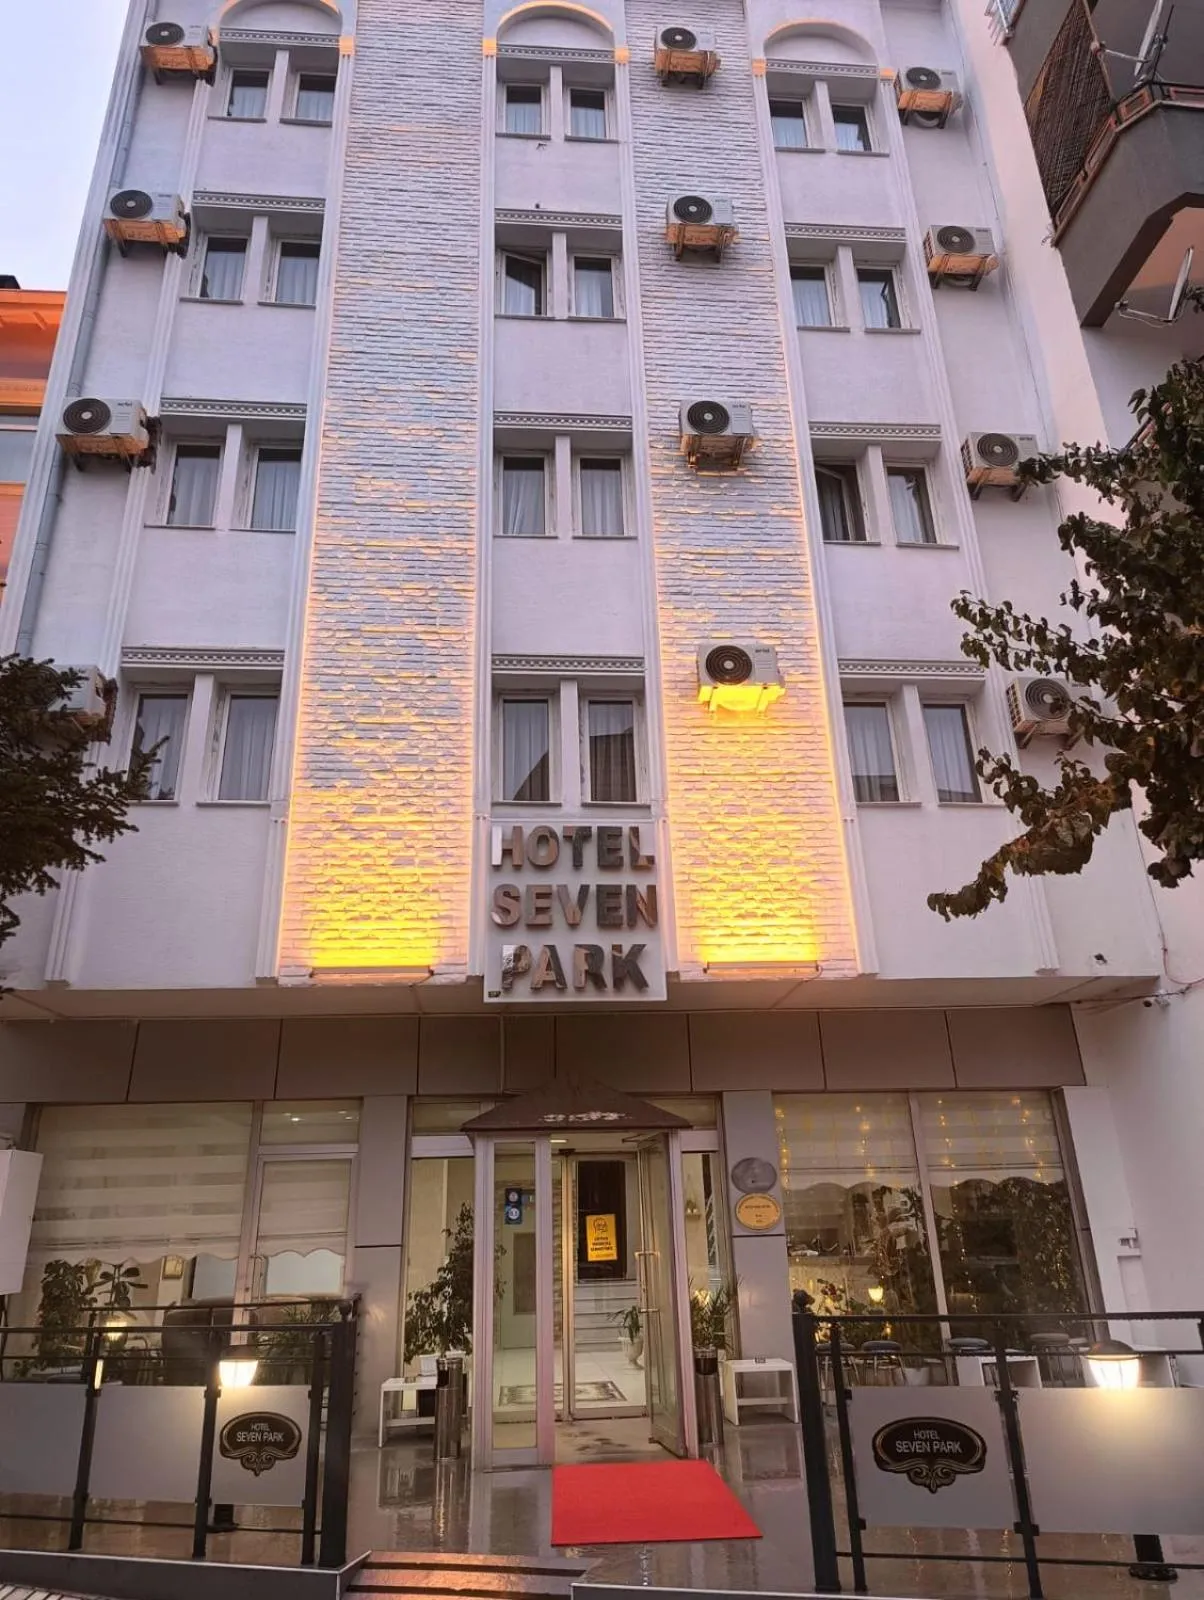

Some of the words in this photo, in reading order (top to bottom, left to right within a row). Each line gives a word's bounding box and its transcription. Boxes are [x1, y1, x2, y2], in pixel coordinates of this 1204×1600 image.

[491, 825, 655, 869] HOTEL
[491, 884, 658, 929] SEVEN
[501, 944, 649, 990] PARK
[251, 1423, 270, 1431] HOTEL
[236, 1431, 261, 1442] SEVEN
[263, 1431, 284, 1442] PARK
[913, 1430, 940, 1439] HOTEL
[896, 1441, 931, 1453] SEVEN
[933, 1441, 962, 1453] PARK
